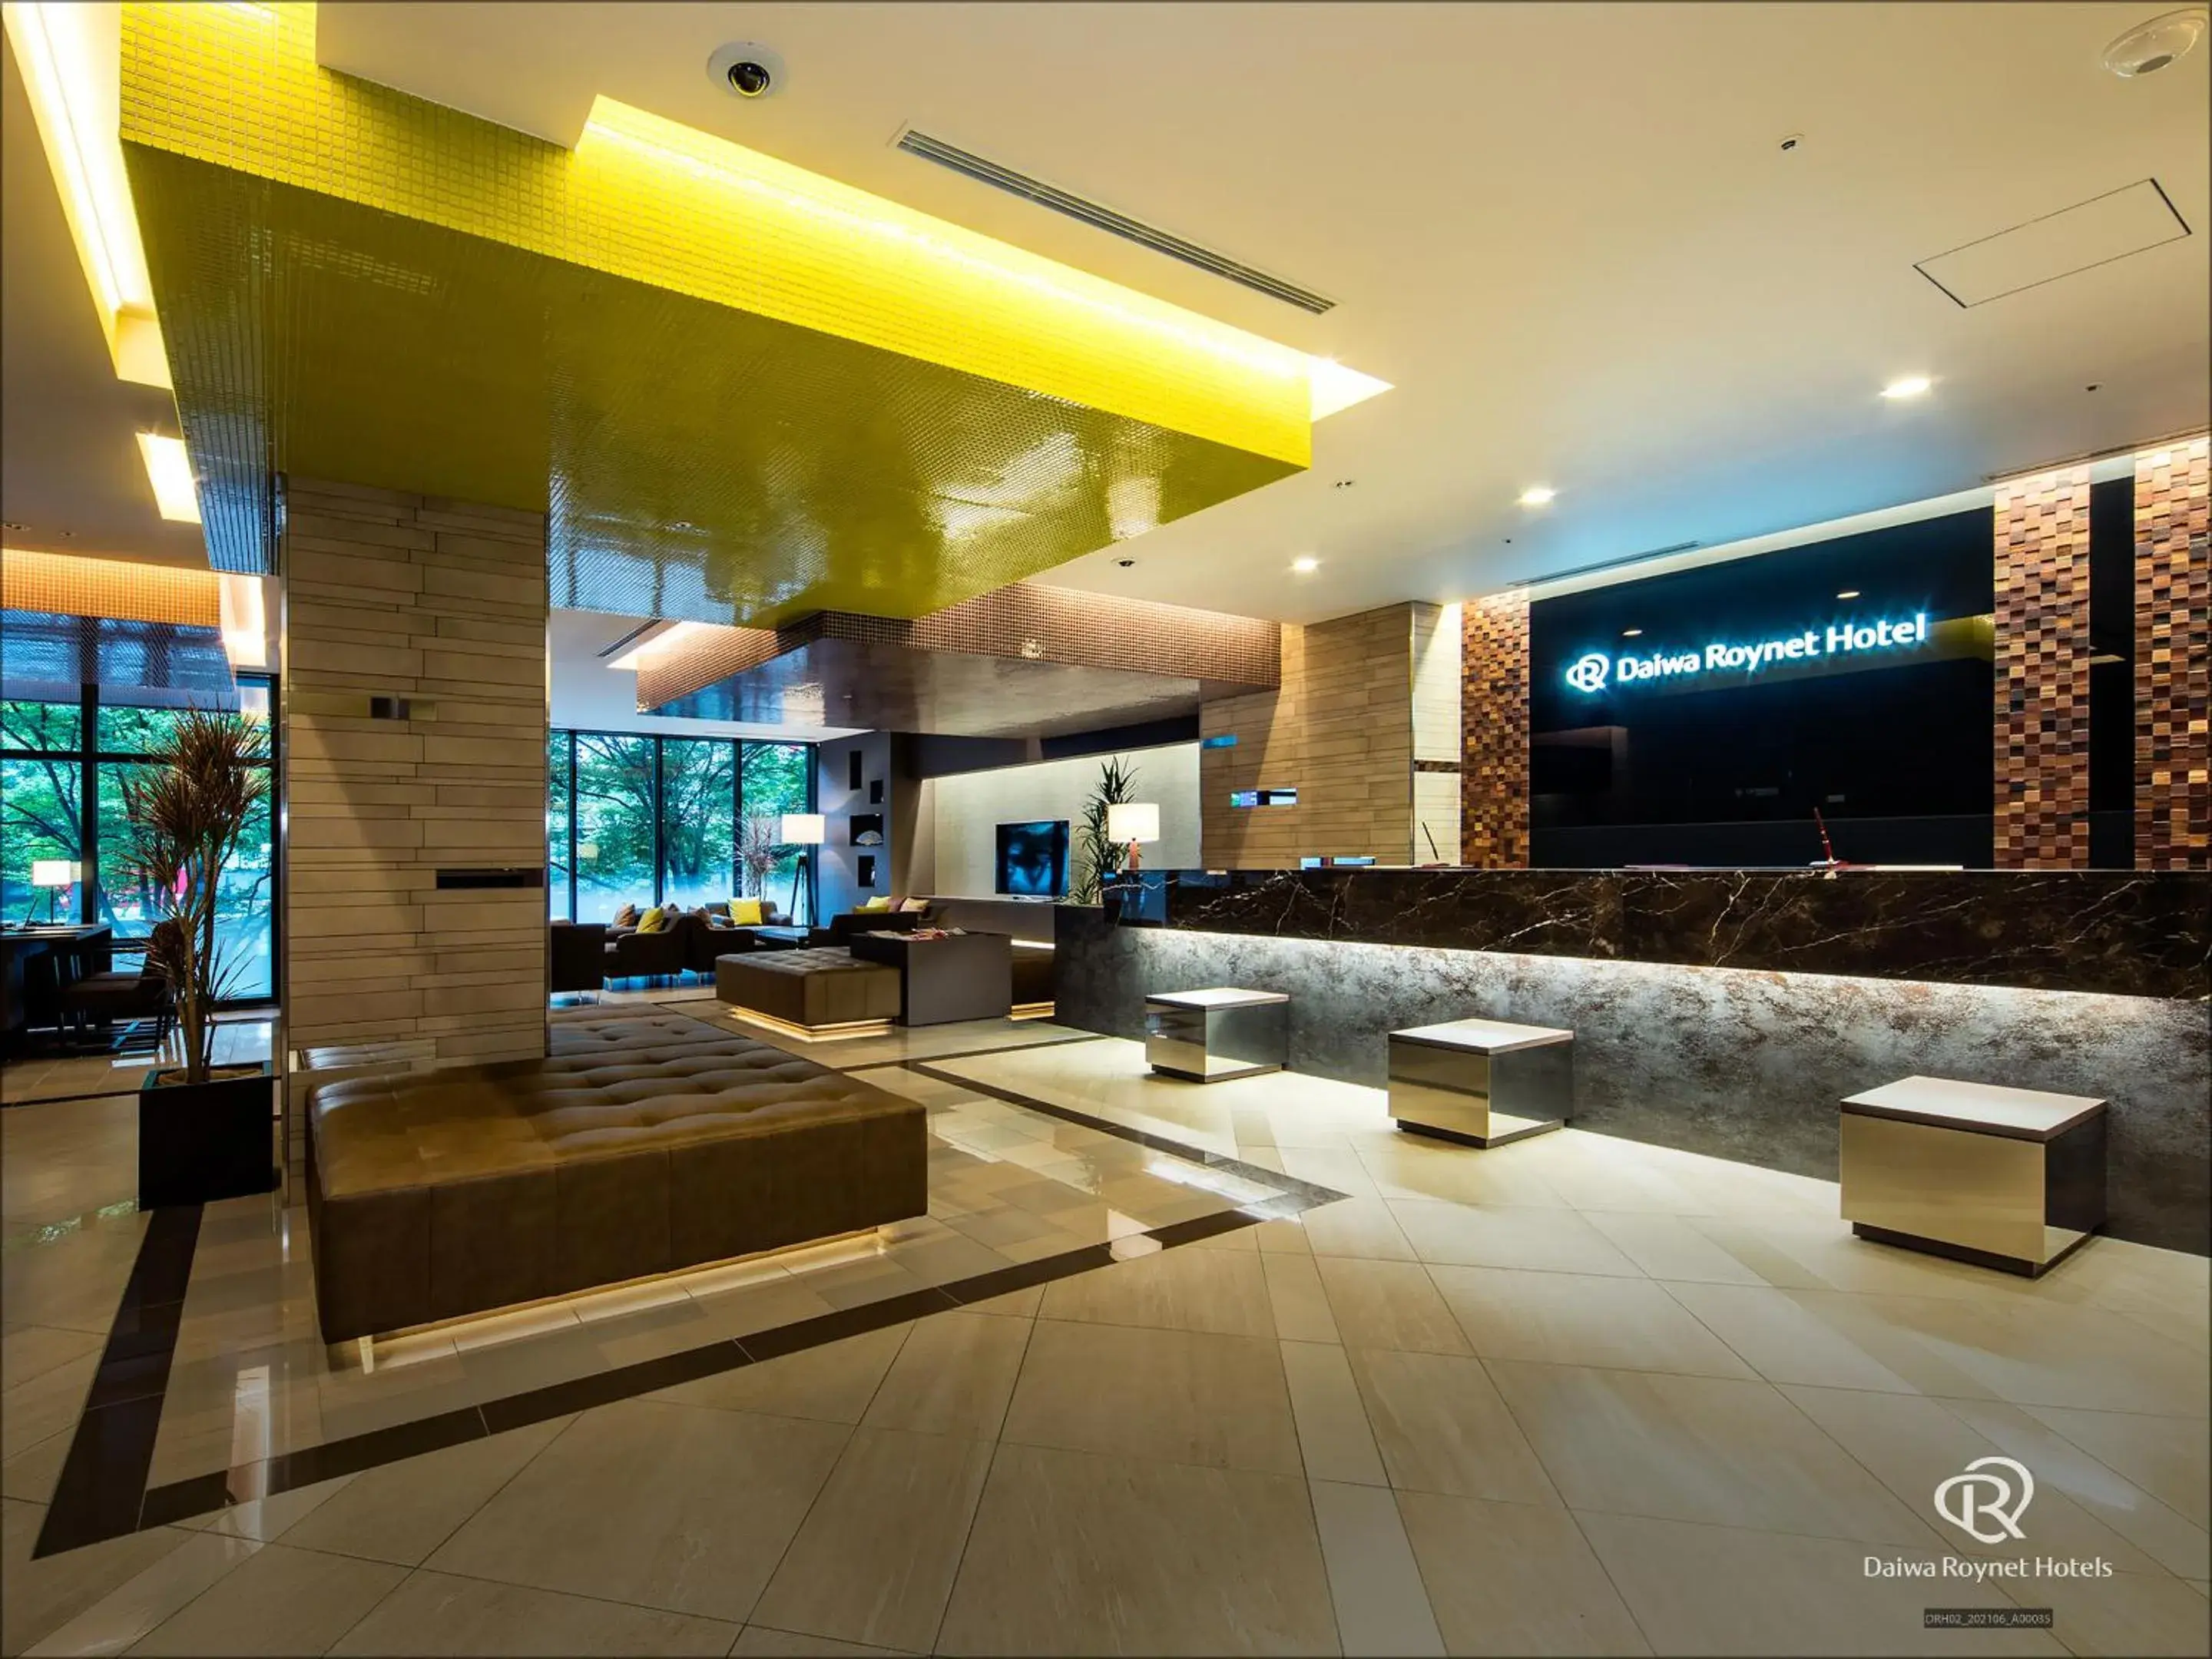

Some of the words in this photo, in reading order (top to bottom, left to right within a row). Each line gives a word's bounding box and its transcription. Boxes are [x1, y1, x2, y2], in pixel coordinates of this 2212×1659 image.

[1617, 653, 1700, 682] Daiwa
[1705, 633, 1820, 671] Roynet
[1826, 613, 1926, 653] Hotel
